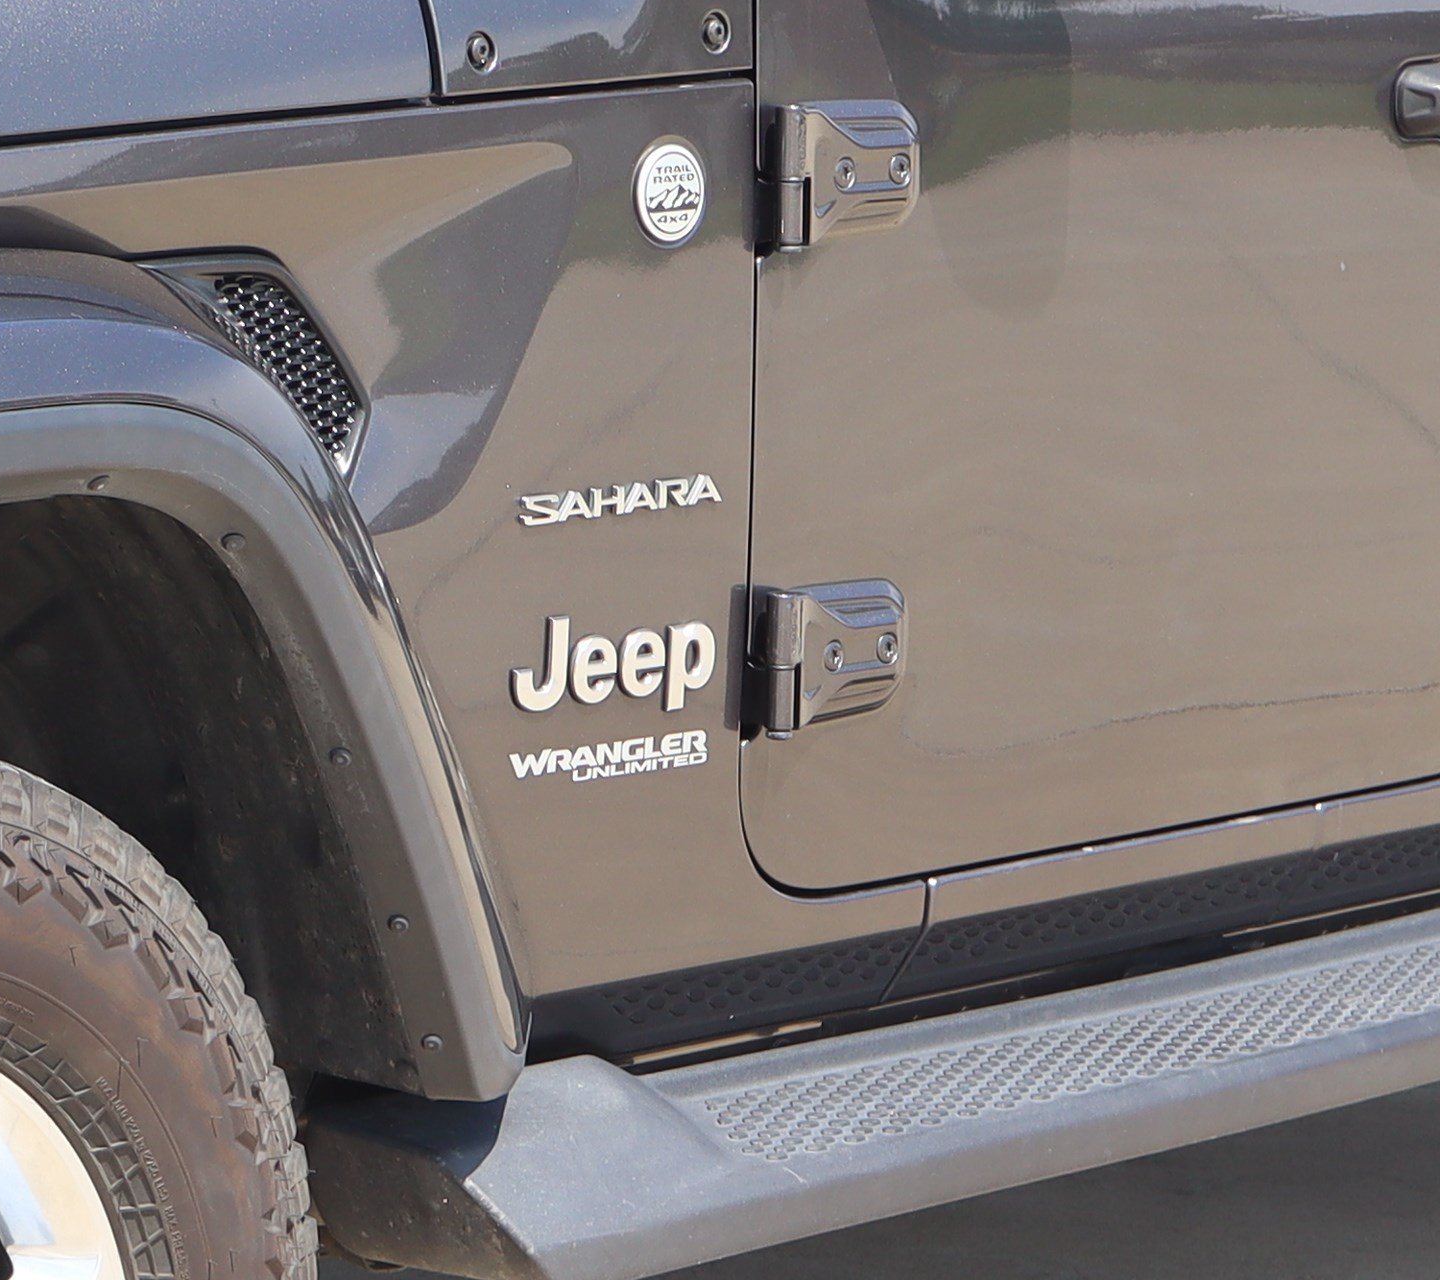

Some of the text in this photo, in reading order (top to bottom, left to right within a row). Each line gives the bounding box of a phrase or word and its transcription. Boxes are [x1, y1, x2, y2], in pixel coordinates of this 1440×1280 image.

[652, 173, 695, 185] RATED
[655, 164, 693, 176] TRAIL
[518, 472, 723, 528] SAHARA
[508, 614, 717, 714] Jeep
[508, 729, 708, 780] WRANGLER
[571, 750, 708, 782] UNLIMITED
